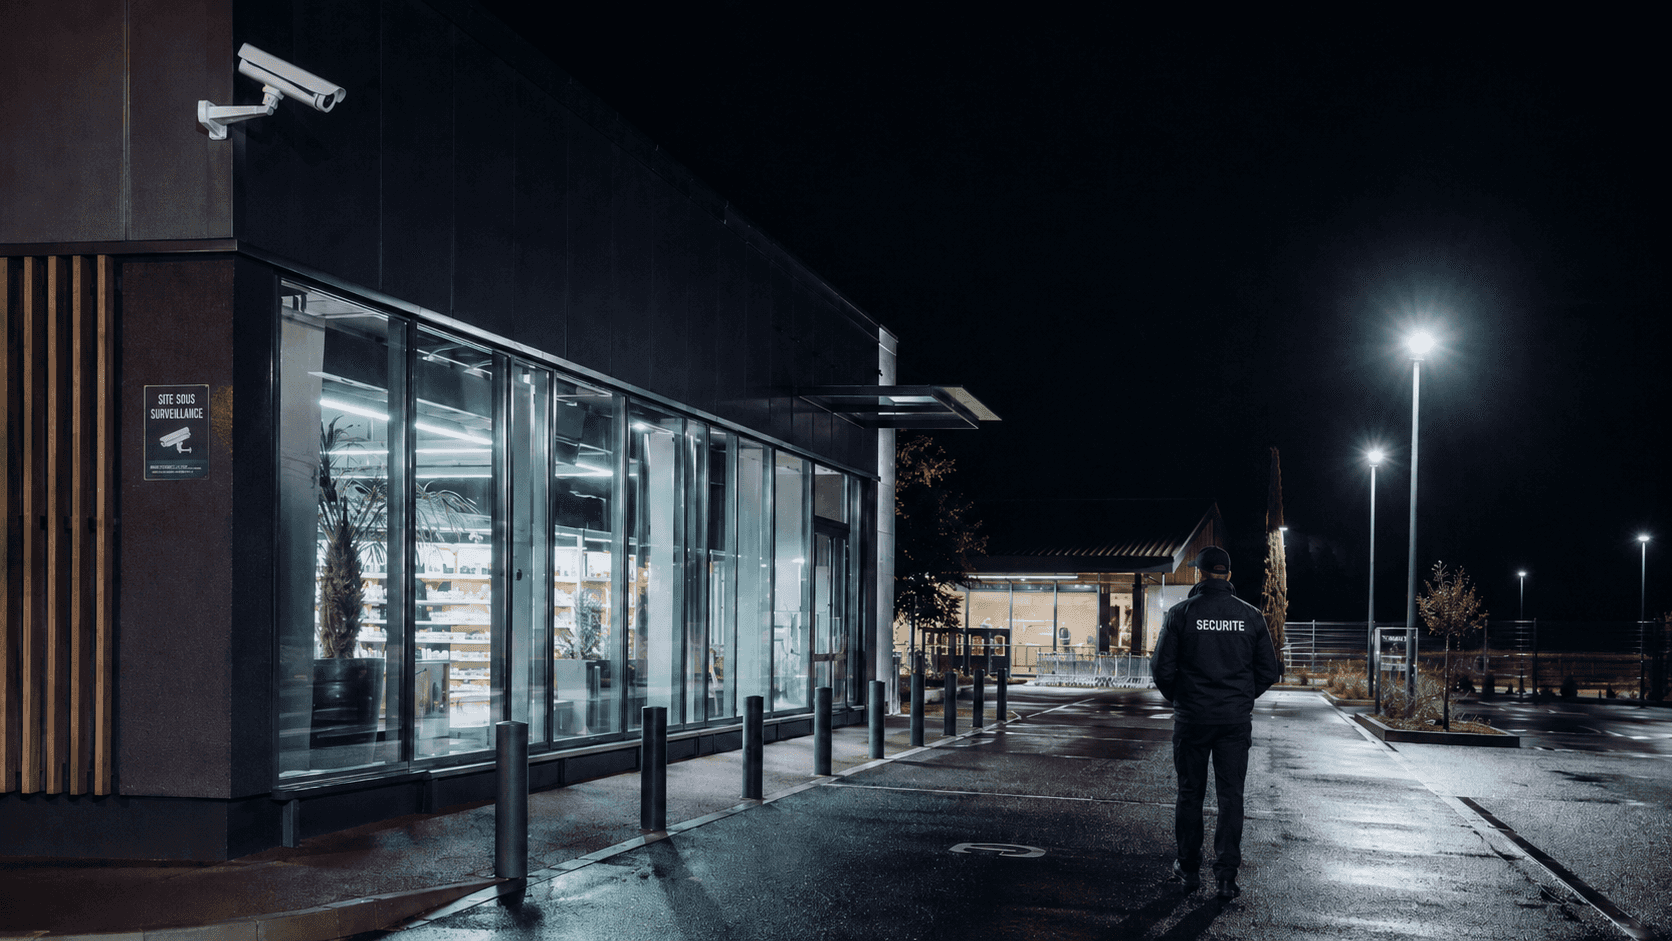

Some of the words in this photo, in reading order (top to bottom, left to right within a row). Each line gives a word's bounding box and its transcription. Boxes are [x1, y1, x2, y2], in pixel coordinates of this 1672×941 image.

[158, 393, 174, 405] SITE
[176, 393, 196, 404] SOUS
[150, 407, 203, 419] SURVEILLANCE
[1196, 619, 1245, 631] SECURITE
